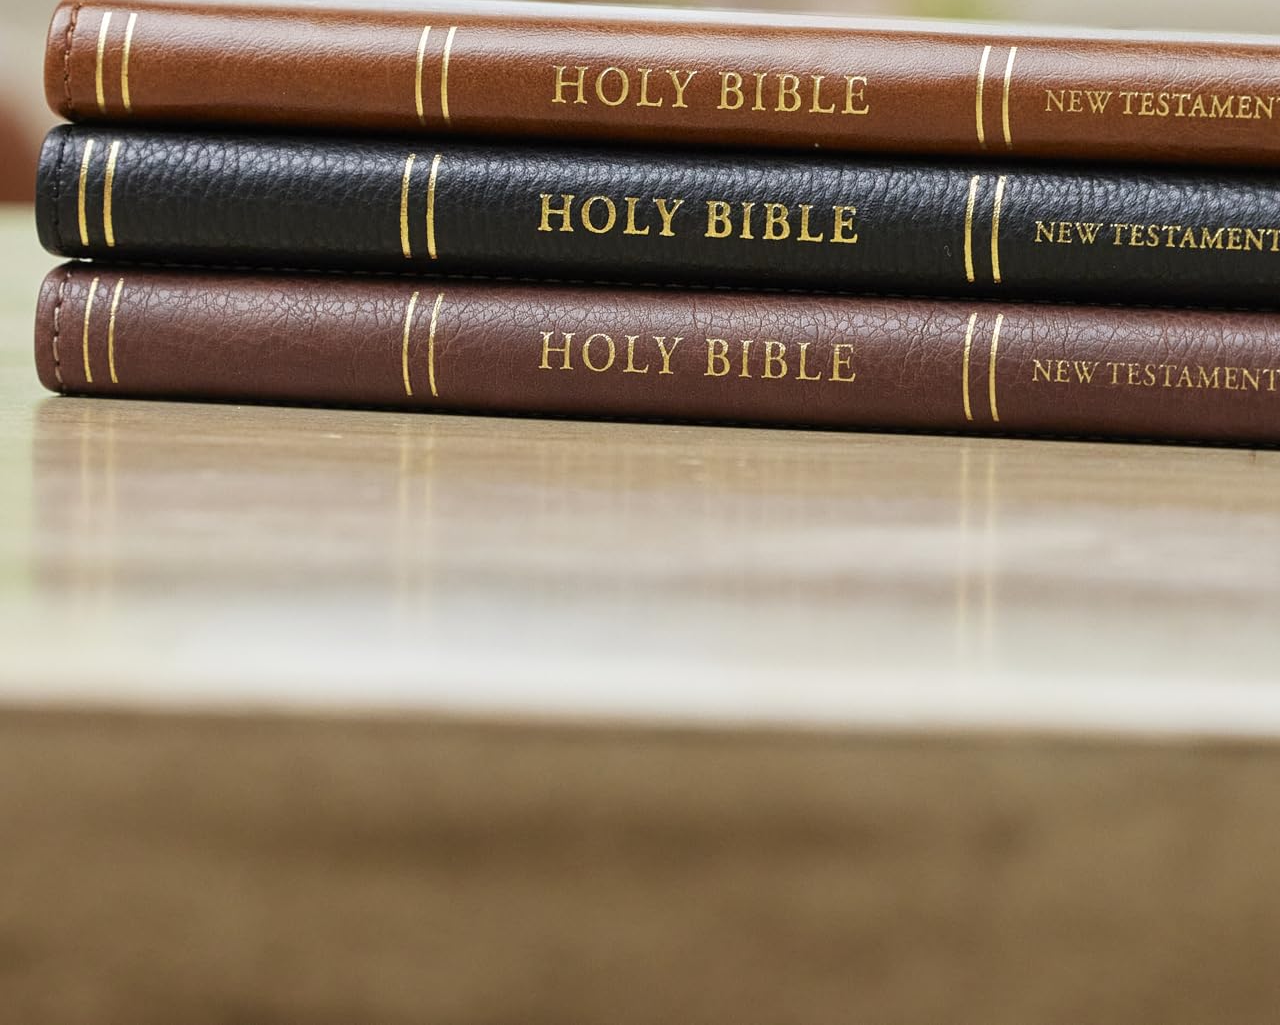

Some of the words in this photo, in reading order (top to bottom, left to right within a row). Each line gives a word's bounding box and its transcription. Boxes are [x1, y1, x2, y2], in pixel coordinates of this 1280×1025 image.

[551, 64, 698, 109] HOLY
[717, 71, 870, 115] BIBLE
[1045, 89, 1112, 114] NEW
[537, 193, 685, 237] HOLY
[704, 200, 858, 244] BIBLE
[1034, 221, 1103, 245] NEW
[538, 331, 684, 375] HOLY
[703, 338, 856, 382] BIBLE
[1032, 359, 1100, 384] NEW
[1106, 362, 1280, 391] TESTAMENT
